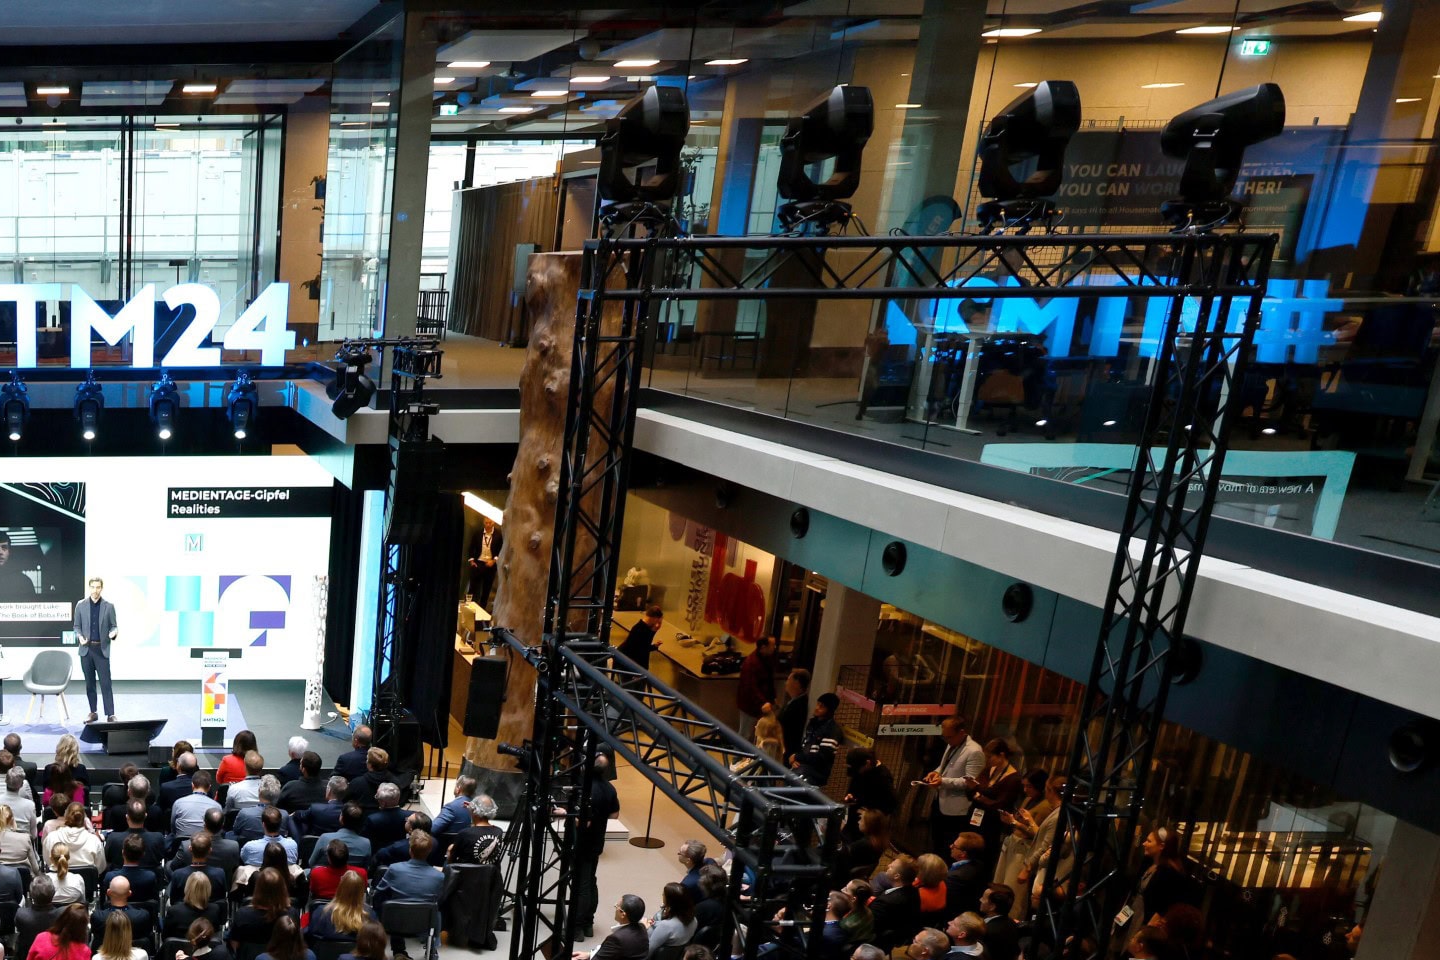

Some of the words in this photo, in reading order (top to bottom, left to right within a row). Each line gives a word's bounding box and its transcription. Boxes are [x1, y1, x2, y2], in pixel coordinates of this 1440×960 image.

[1069, 164, 1103, 177] YOU
[1106, 164, 1141, 177] CAN
[1060, 183, 1092, 196] YOU
[1096, 183, 1130, 196] CAN
[171, 489, 290, 502] MEDIENTAGE-Gipfel
[171, 504, 220, 514] Realities
[15, 603, 42, 611] brought
